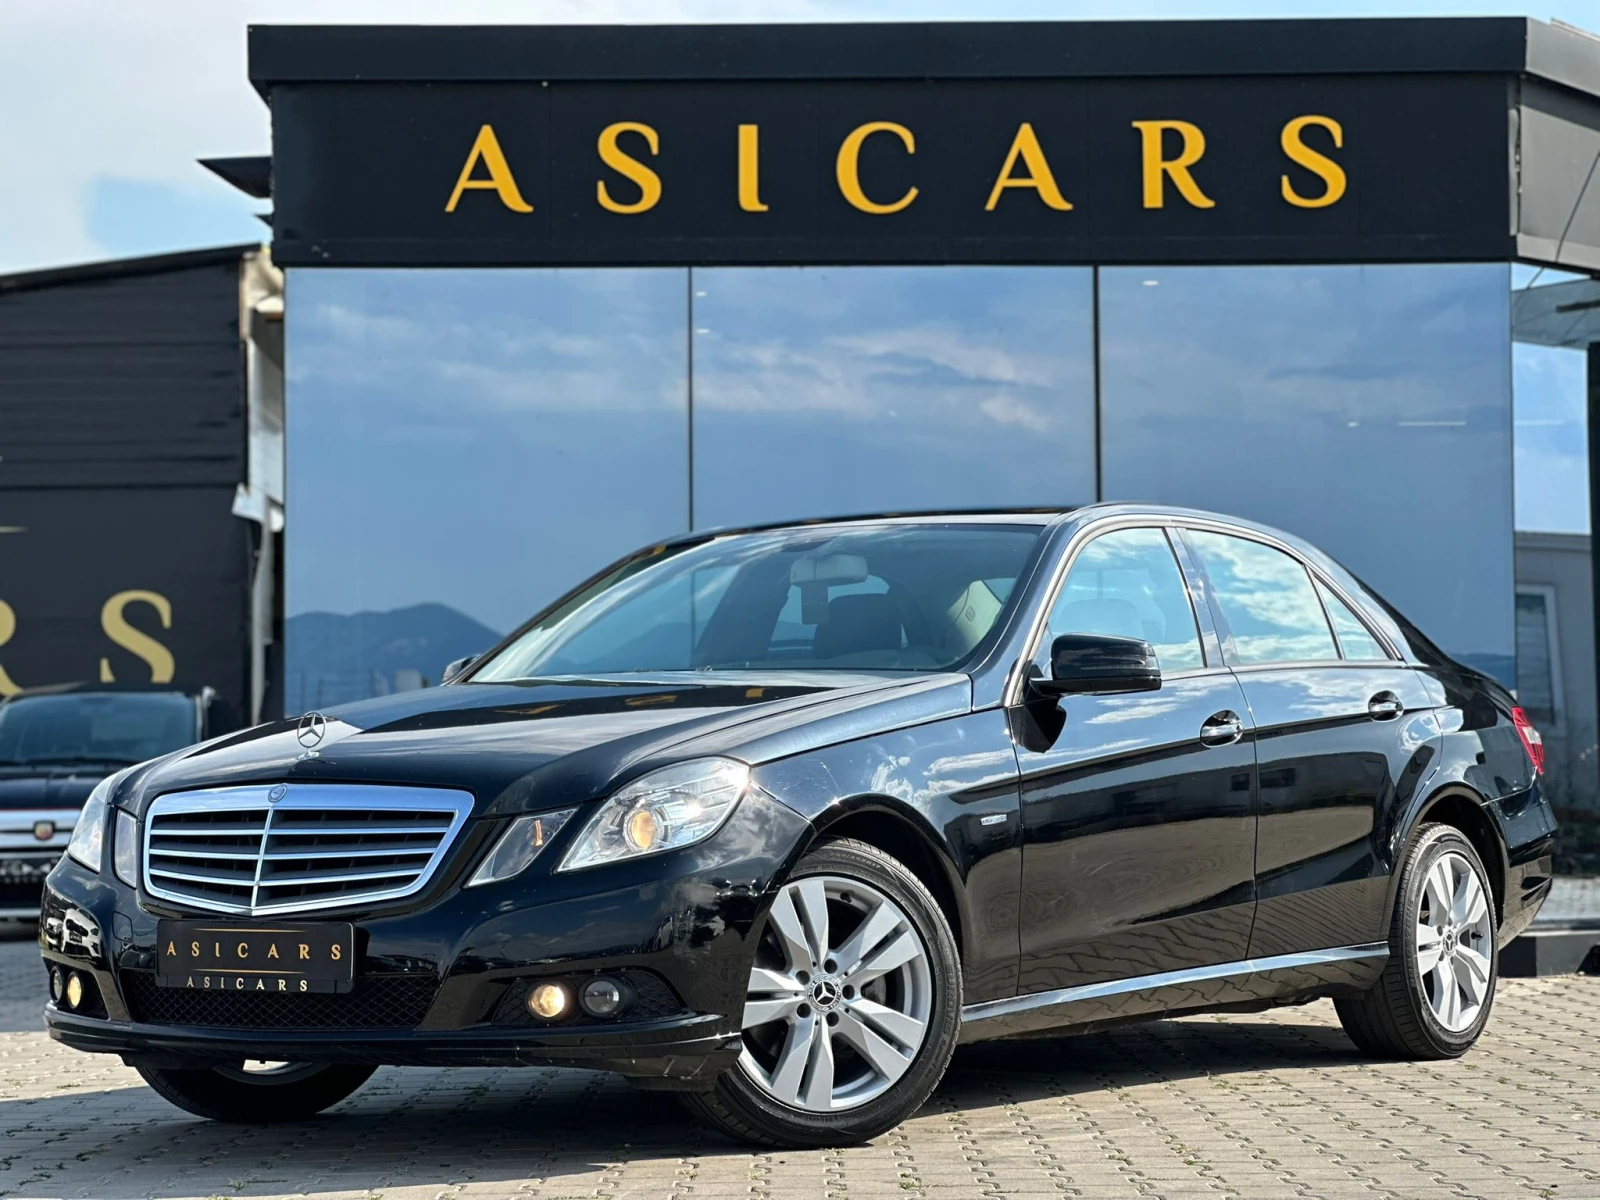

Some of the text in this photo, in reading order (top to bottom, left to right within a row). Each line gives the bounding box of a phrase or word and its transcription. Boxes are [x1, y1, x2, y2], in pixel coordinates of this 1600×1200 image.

[445, 115, 1347, 215] ASICARS
[166, 941, 341, 960] ASICARS
[186, 976, 308, 992] ASICARS
